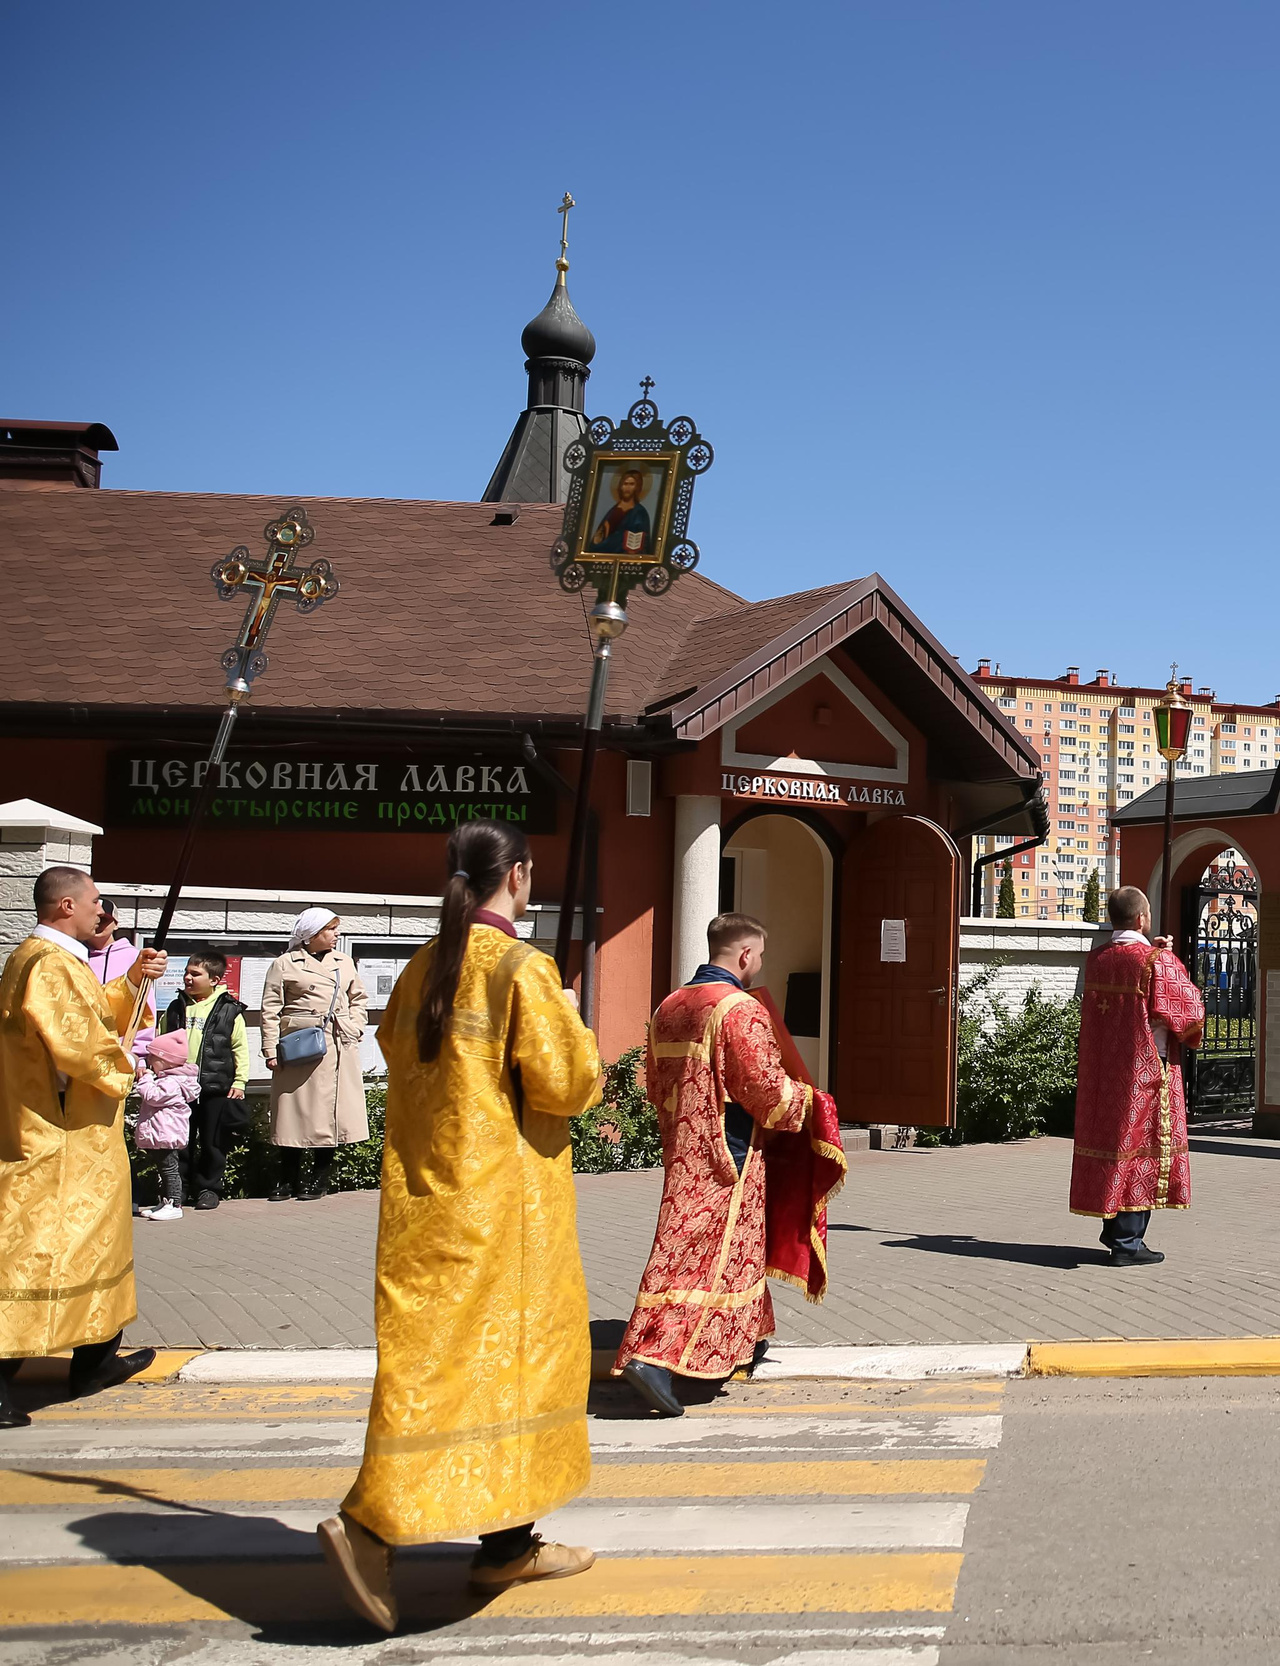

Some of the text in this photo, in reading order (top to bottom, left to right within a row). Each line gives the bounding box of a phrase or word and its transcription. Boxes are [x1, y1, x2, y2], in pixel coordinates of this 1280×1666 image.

[129, 760, 531, 795] ЦЕРКОВНАЯ ЛАВКА
[721, 773, 906, 806] ЦЕРКОВНАЯ ЛАВКА
[132, 797, 359, 825] монстырские
